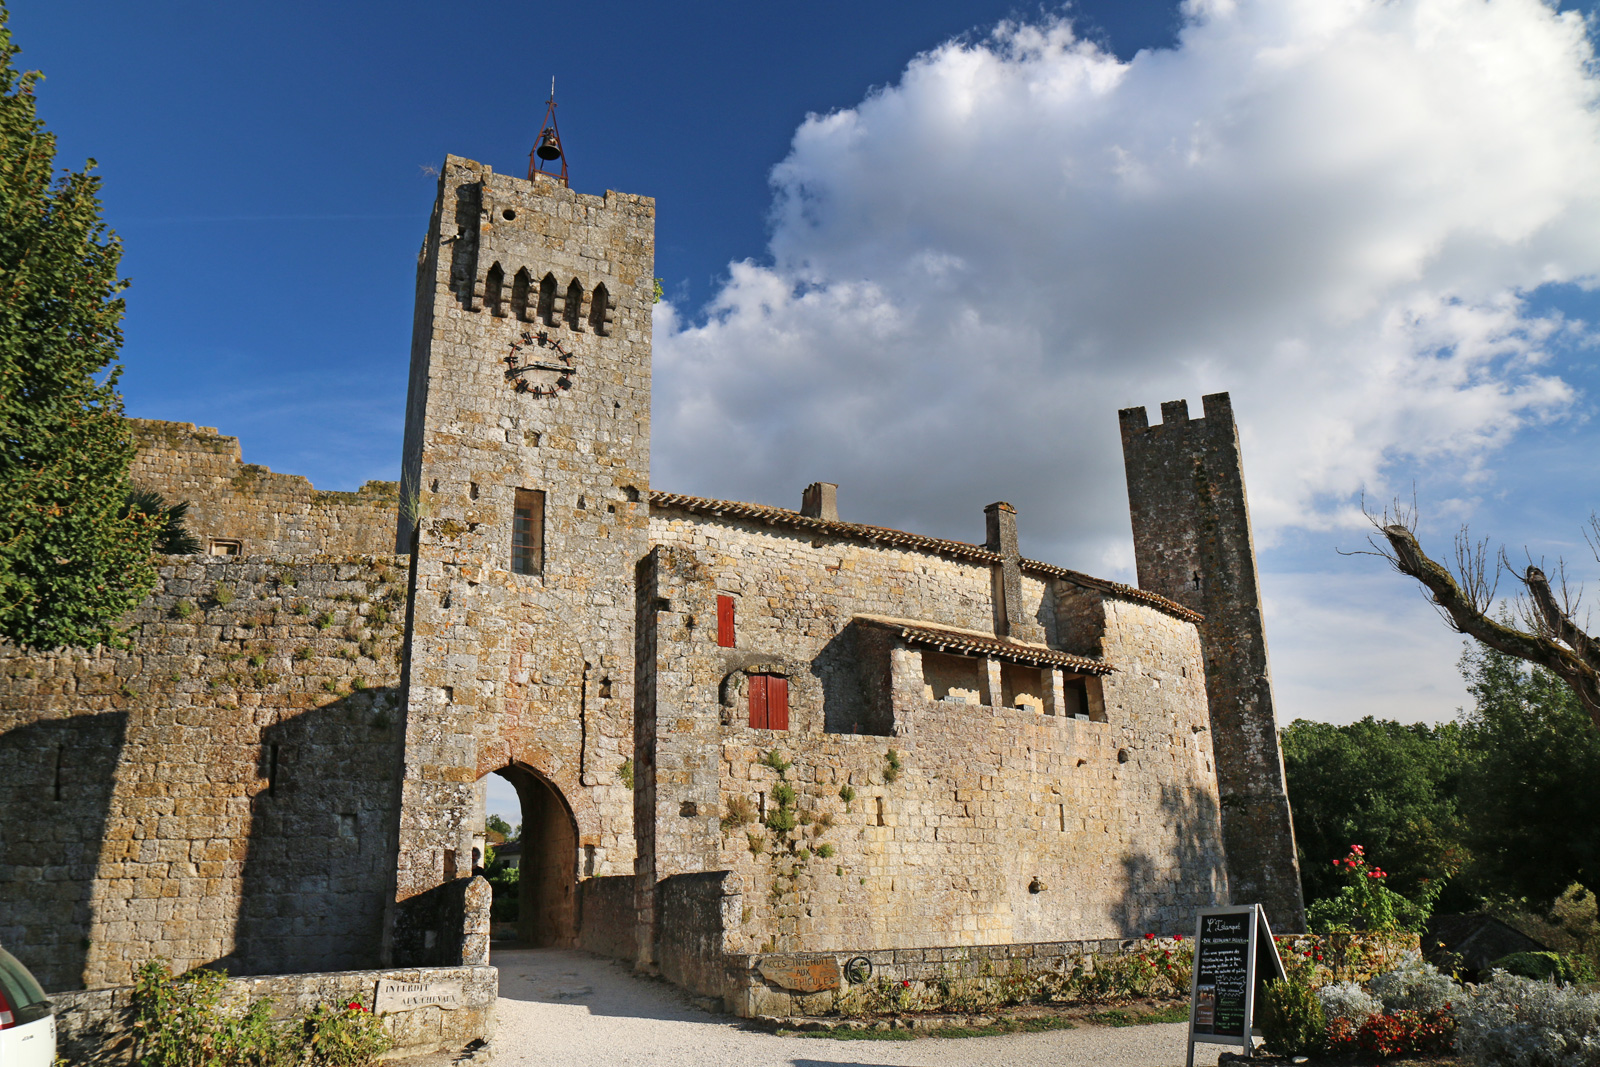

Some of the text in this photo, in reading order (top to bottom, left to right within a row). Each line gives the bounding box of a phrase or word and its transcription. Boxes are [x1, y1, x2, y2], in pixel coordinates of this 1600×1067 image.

[792, 958, 829, 967] INTERDIT
[787, 977, 835, 986] VEHICULES
[385, 984, 430, 993] INTERDIT
[420, 995, 456, 1003] CHEVAUX
